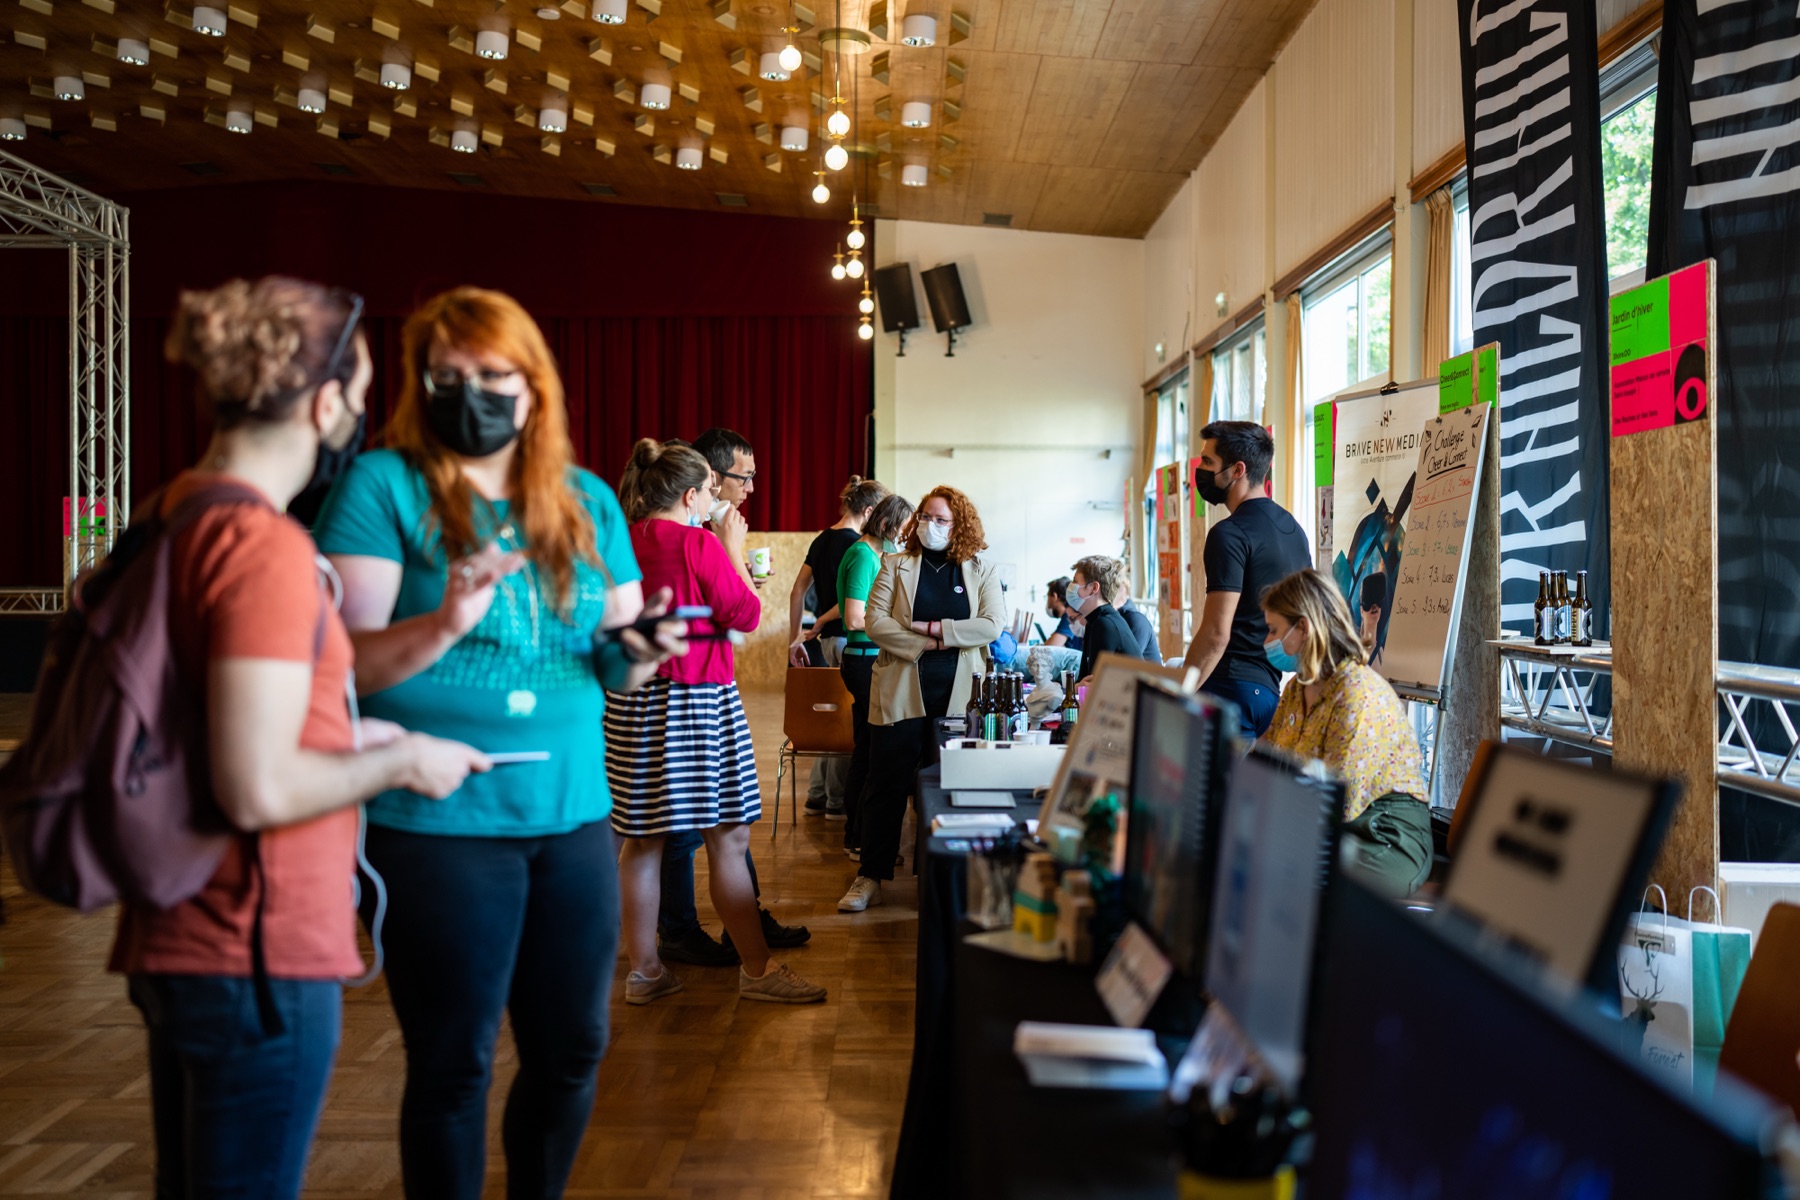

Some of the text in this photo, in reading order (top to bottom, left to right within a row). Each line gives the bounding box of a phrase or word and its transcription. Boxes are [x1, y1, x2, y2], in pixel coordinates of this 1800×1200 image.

[1612, 311, 1630, 326] Jardin
[1346, 440, 1371, 458] BRAVE
[1373, 437, 1395, 454] NEW
[1434, 425, 1465, 451] Challenge
[1428, 456, 1443, 473] Cheer
[1449, 446, 1468, 465] Connect
